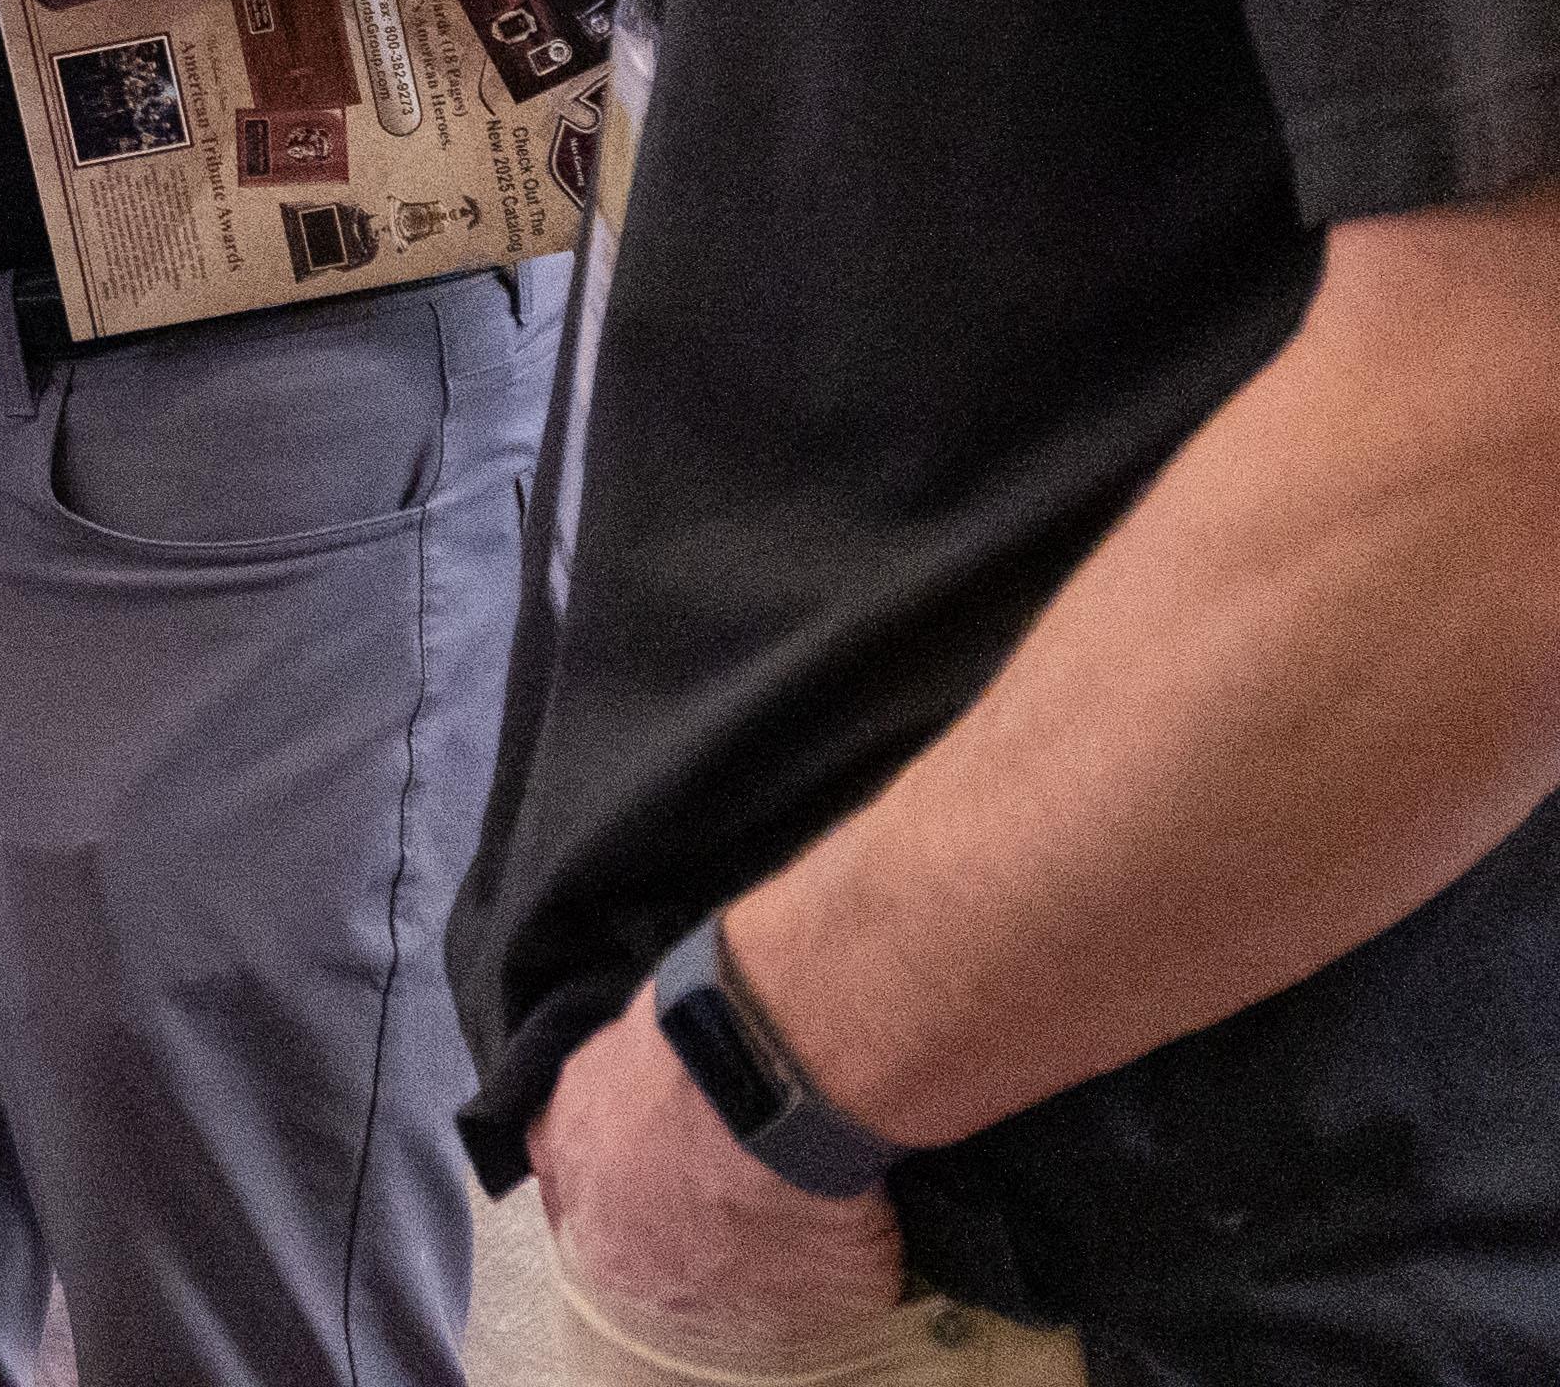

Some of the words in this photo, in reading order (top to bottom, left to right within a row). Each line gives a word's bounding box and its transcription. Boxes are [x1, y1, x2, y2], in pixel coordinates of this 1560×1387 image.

[382, 24, 414, 116] 800-382-9273
[177, 32, 214, 129] American
[199, 132, 230, 202] Tribute
[215, 203, 246, 273] Awards
[483, 118, 506, 155] New
[509, 126, 535, 174] Check
[491, 155, 514, 193] 2025
[521, 177, 542, 207] Out
[496, 193, 528, 254] Catalog
[528, 207, 548, 236] The
